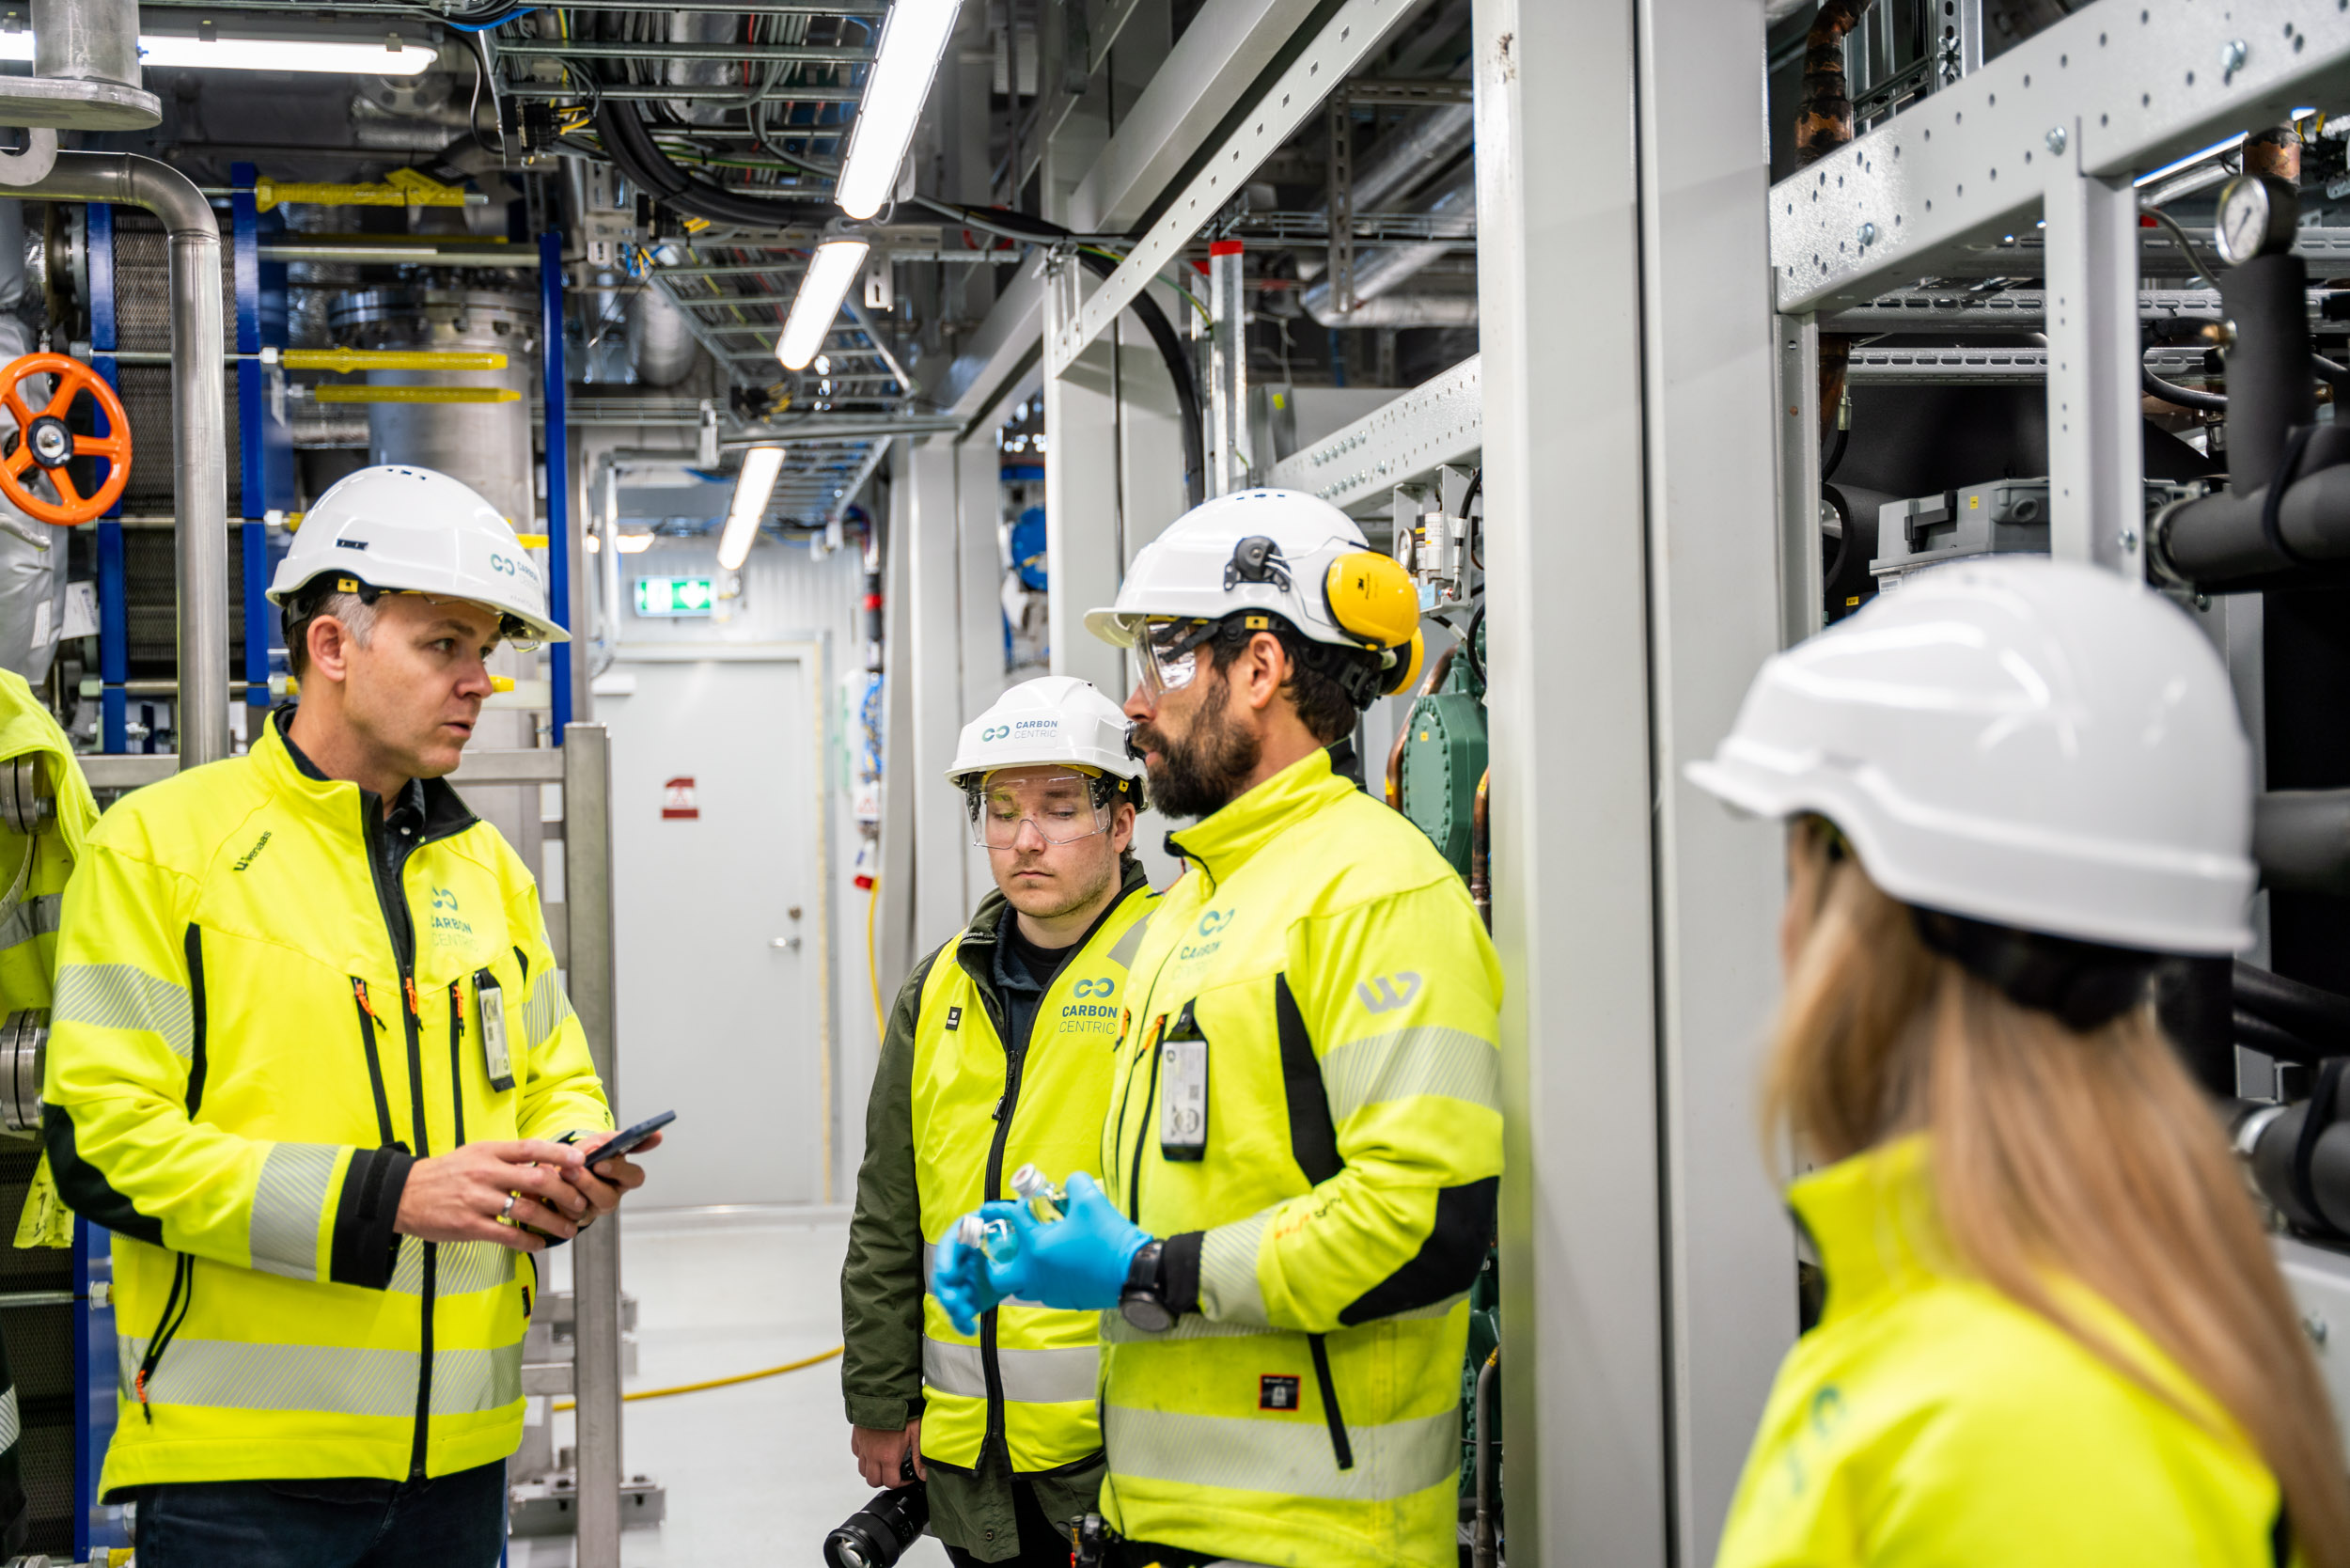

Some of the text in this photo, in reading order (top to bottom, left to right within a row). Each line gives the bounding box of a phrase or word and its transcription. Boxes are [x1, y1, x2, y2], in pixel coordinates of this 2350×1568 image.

[1015, 720, 1058, 729] CARBON
[1014, 729, 1058, 740] CENTRIC
[1061, 1004, 1119, 1019] CARBON
[1058, 1020, 1116, 1035] CENTRIC
